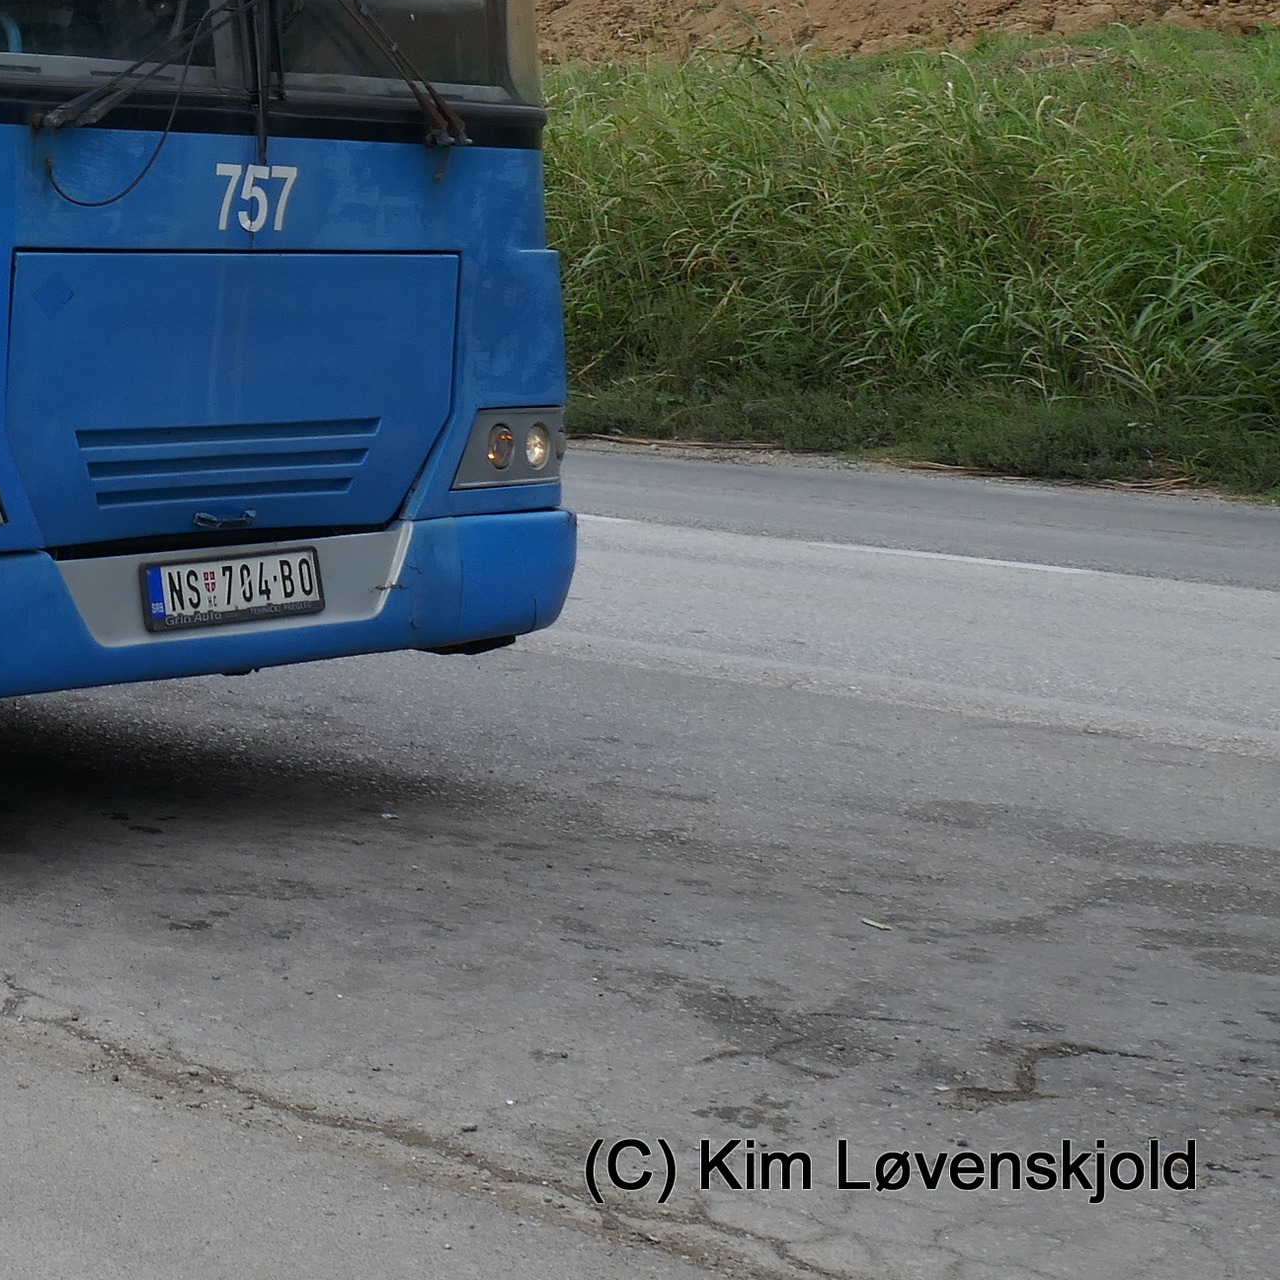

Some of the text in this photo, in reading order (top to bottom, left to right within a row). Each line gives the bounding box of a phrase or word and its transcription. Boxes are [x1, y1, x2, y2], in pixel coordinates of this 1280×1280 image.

[216, 163, 298, 232] 757
[168, 569, 201, 612] NS
[151, 602, 164, 613] SRB
[165, 610, 222, 626] Grin Auto
